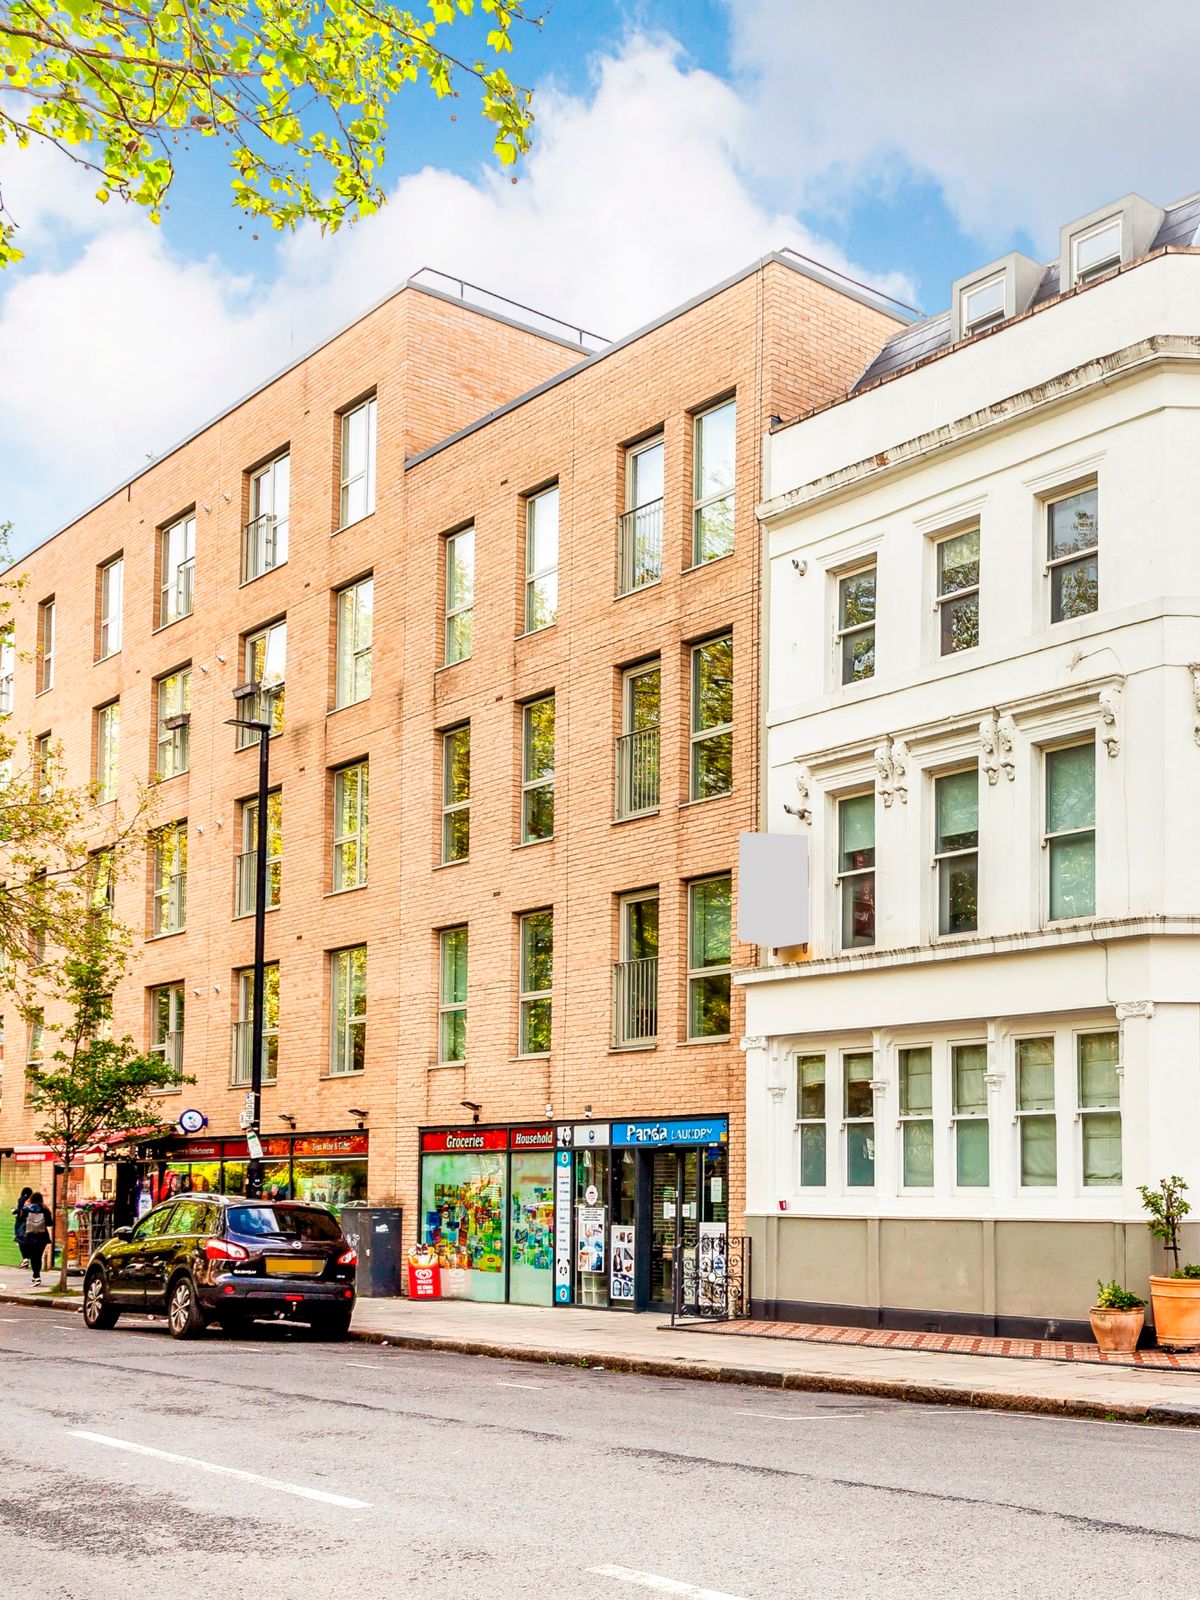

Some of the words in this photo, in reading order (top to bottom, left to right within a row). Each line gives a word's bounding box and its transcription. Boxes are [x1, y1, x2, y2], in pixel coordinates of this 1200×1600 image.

[515, 1131, 553, 1144] Household
[626, 1123, 668, 1142] Panda
[671, 1128, 713, 1140] LAUNDRY
[446, 1133, 484, 1148] Groceries
